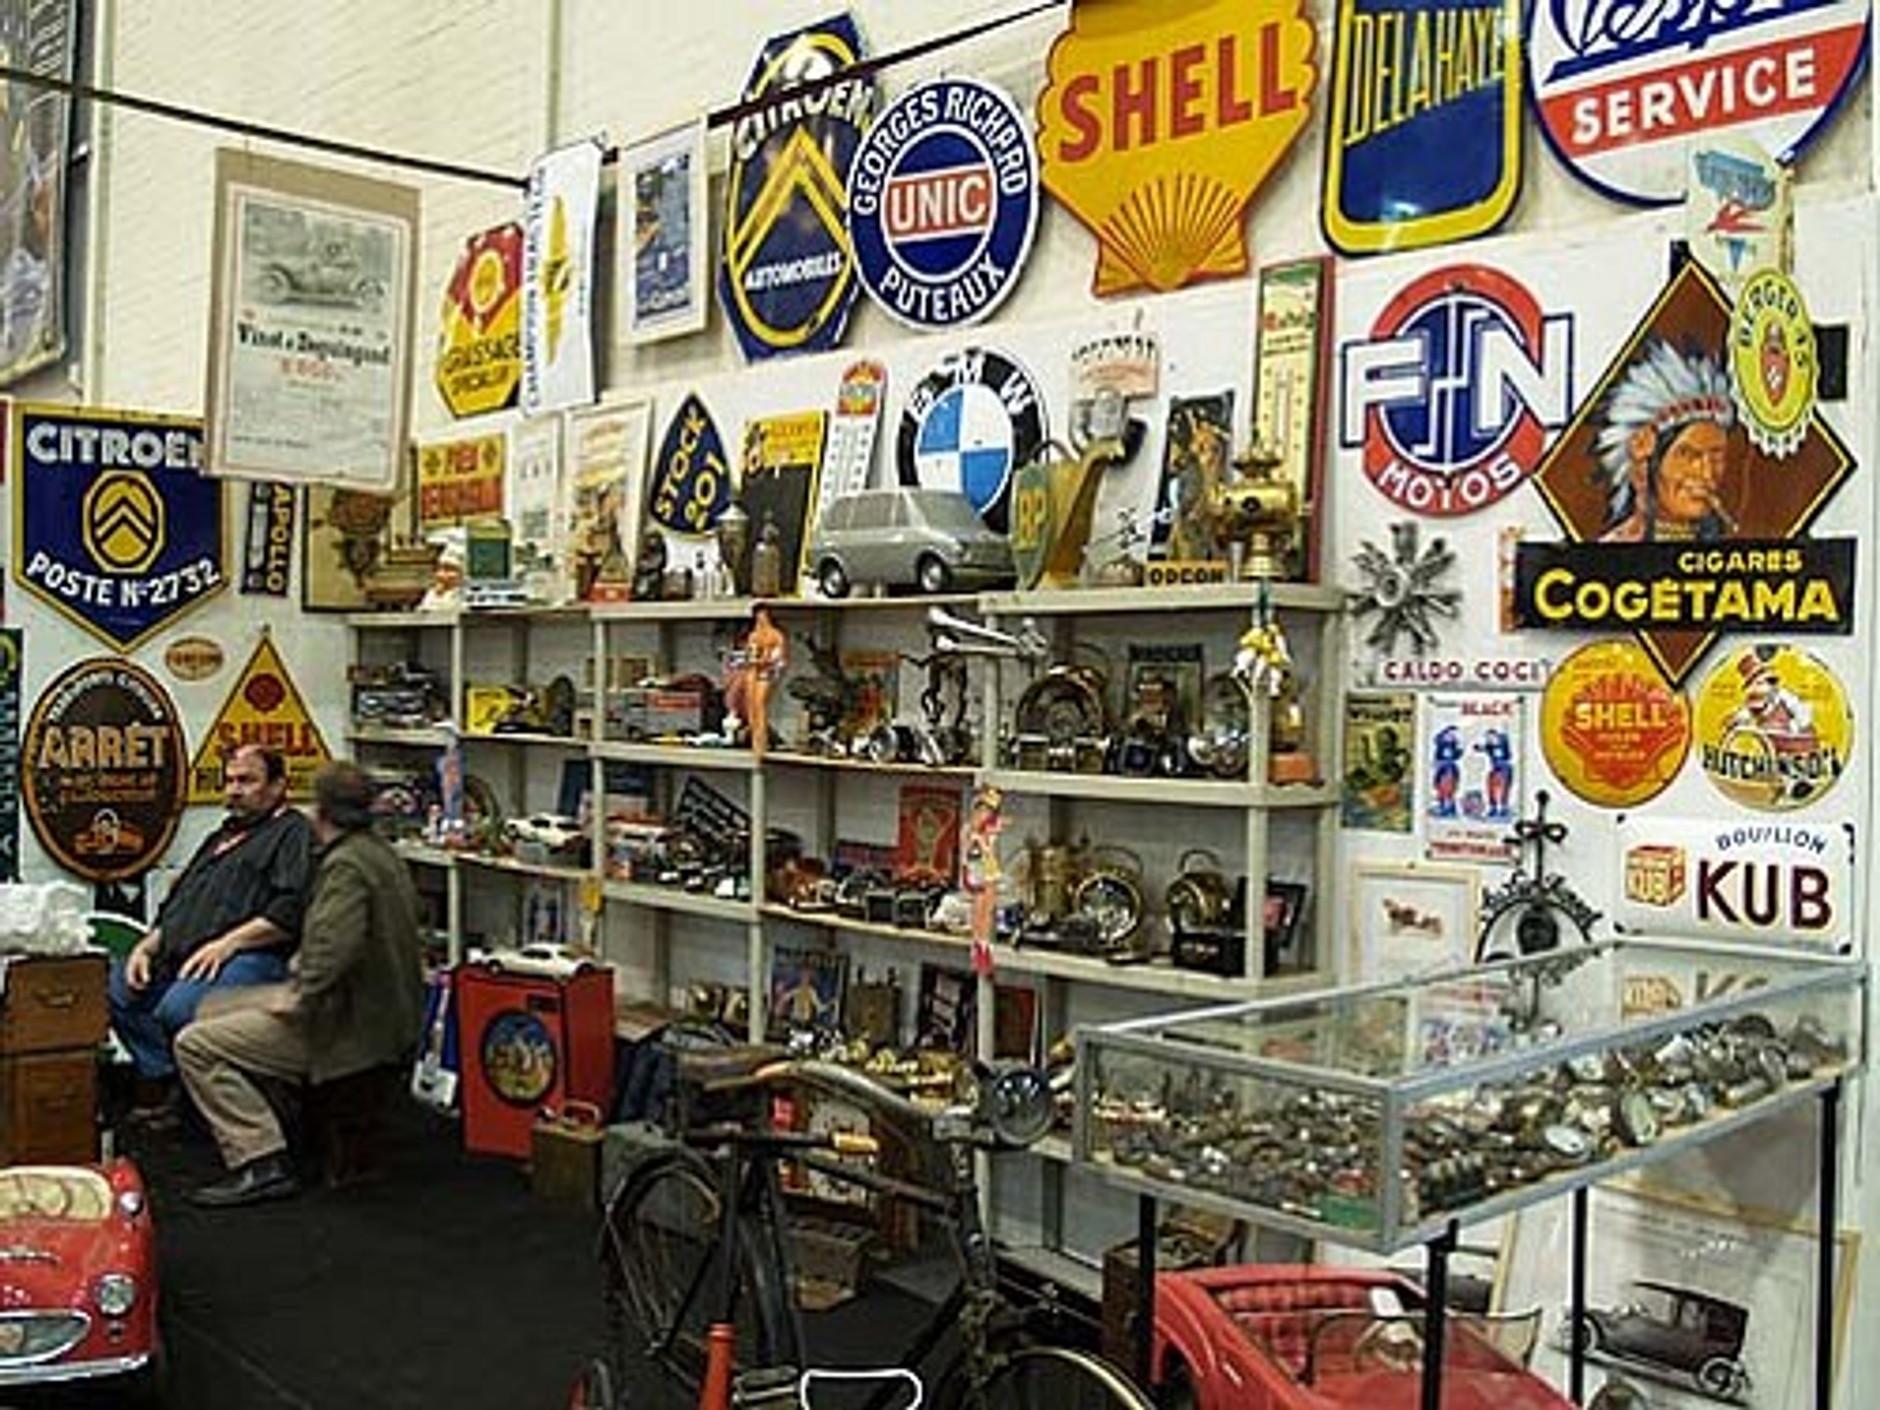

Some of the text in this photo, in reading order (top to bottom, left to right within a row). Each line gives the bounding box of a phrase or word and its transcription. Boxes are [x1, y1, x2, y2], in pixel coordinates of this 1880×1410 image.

[1059, 22, 1297, 162] SHELL
[1343, 7, 1506, 146] DELAHAYE
[1571, 47, 1816, 145] SERVICE
[853, 86, 1029, 216] GEORGES RICHARD
[890, 176, 987, 231] UNIC
[745, 250, 842, 291] AUTOMOBILES
[879, 252, 1005, 322] PUTEAUX
[654, 404, 705, 521] STOCK
[1378, 454, 1520, 509] MOTOS
[267, 483, 291, 592] APOLLO
[1677, 549, 1803, 573] CIGARES
[26, 550, 114, 606] POSTE
[1384, 660, 1463, 681] CALDO
[214, 721, 318, 757] SHELL
[1575, 702, 1667, 730] SHELL
[1698, 860, 1833, 930] KUB
